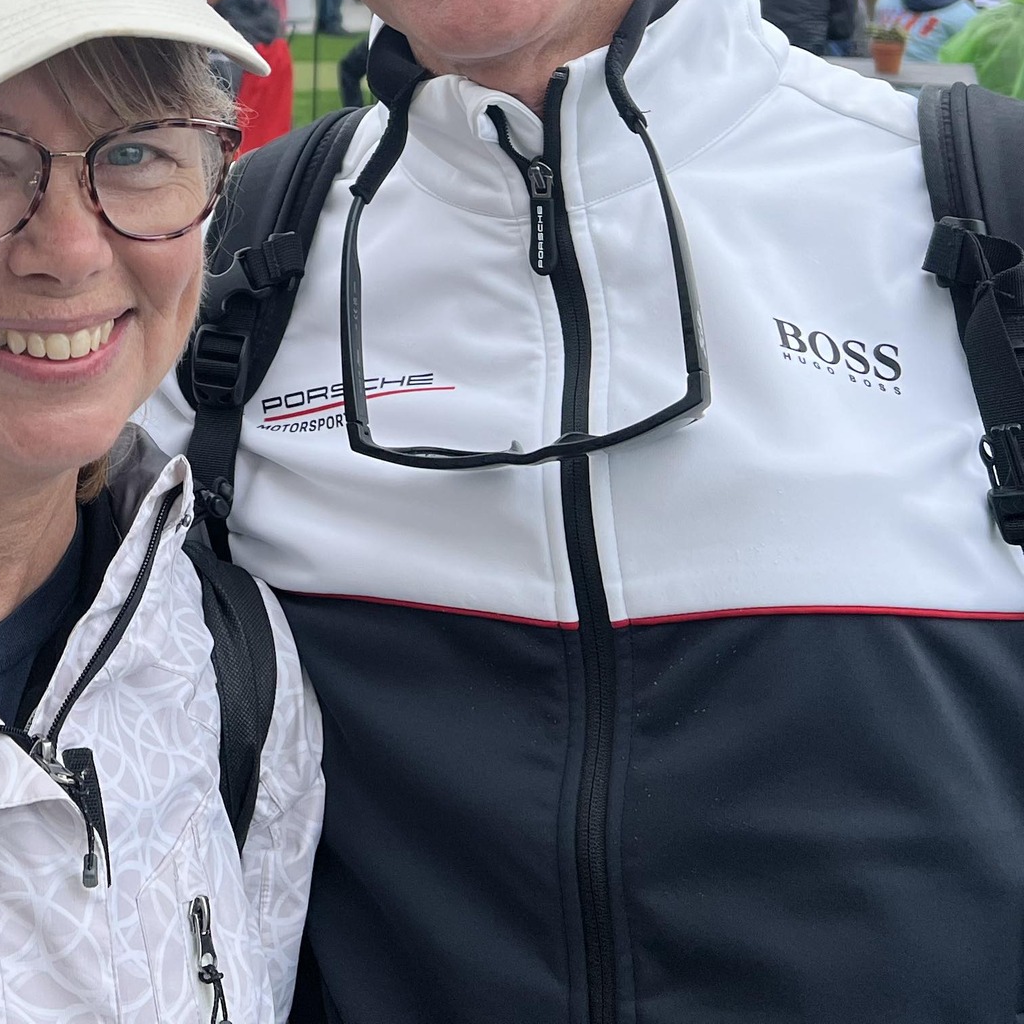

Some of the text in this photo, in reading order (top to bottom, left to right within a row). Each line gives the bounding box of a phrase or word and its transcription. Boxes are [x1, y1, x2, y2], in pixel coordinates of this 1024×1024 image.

[536, 205, 544, 269] PORSCHE
[773, 317, 902, 381] BOSS
[782, 351, 902, 396] HUGO BOSS
[256, 413, 347, 433] MOTORSPOR
